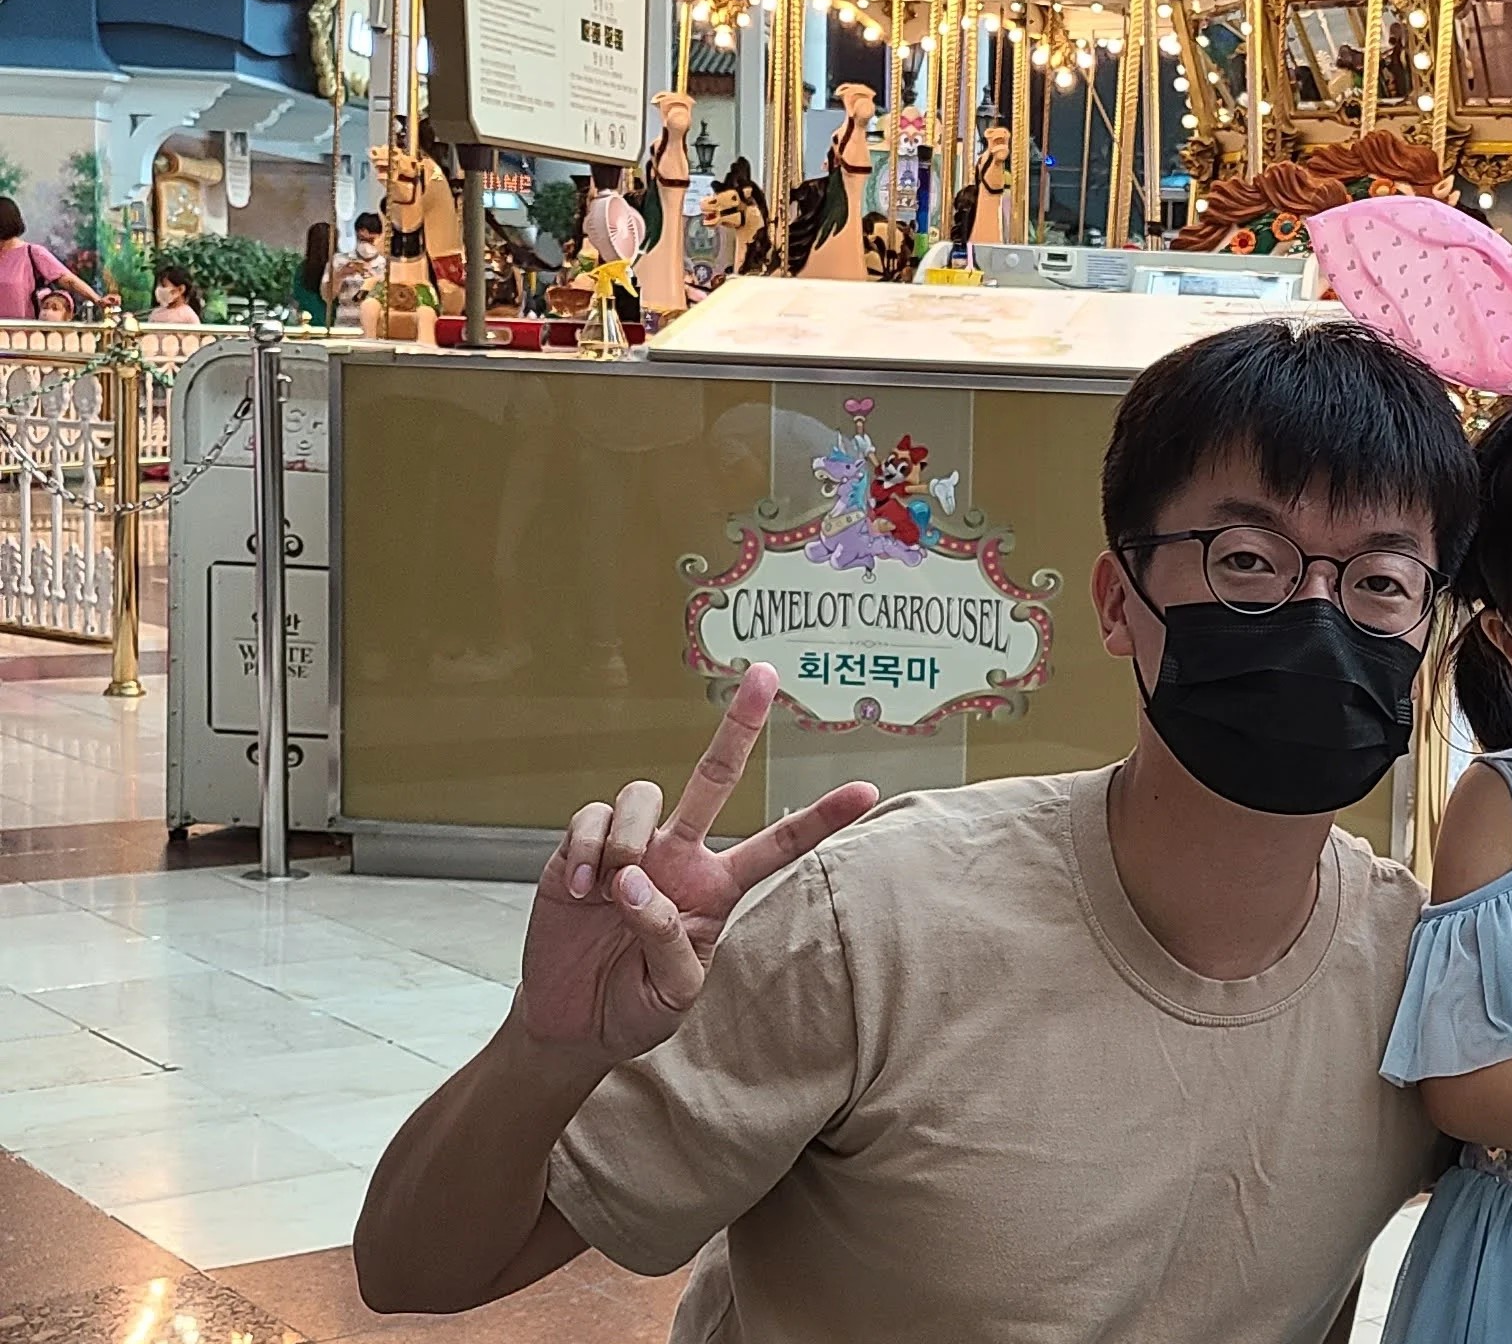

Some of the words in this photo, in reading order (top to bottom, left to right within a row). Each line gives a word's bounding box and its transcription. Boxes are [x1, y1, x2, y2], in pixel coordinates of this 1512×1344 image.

[251, 612, 302, 636] 반
[732, 588, 853, 642] CAMELOT
[858, 593, 1011, 654] CARROUSEL
[239, 643, 314, 664] WTE
[243, 662, 309, 679] PSE
[797, 649, 941, 690] 회전목마
